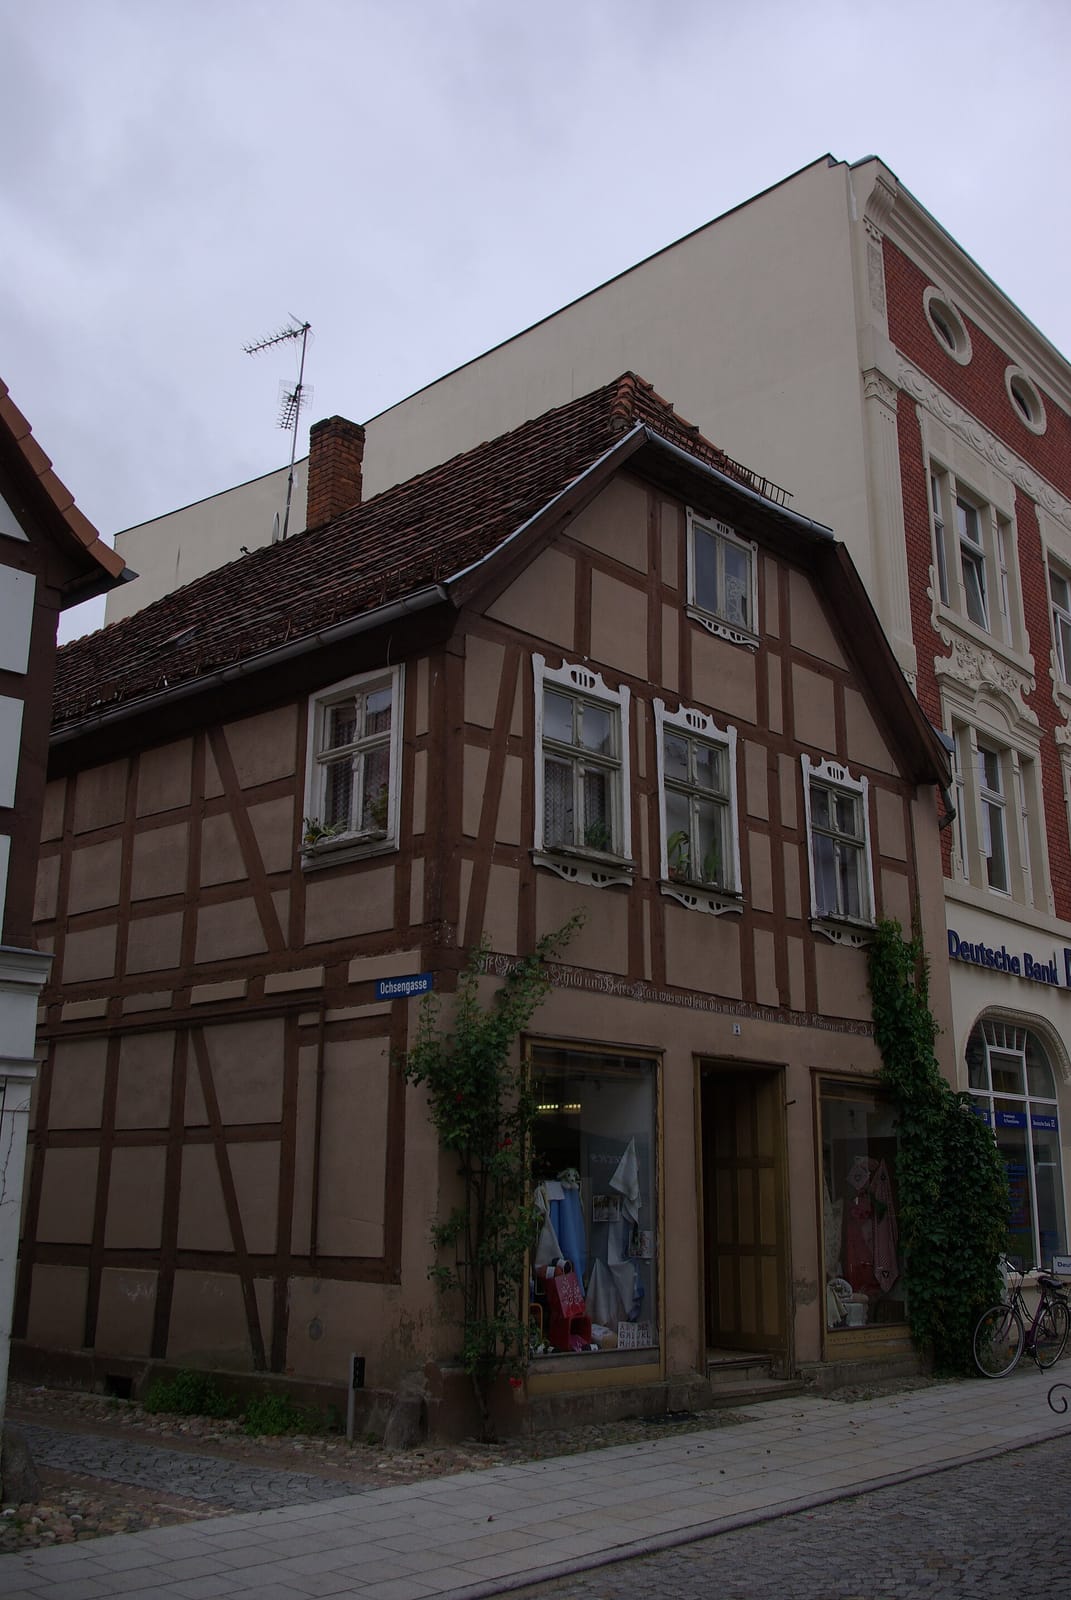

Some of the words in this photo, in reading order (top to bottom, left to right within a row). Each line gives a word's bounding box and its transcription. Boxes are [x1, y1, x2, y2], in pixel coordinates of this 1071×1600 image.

[947, 928, 1021, 975] Deutsche
[1023, 952, 1060, 986] Bank
[380, 979, 427, 994] Ochsengasse
